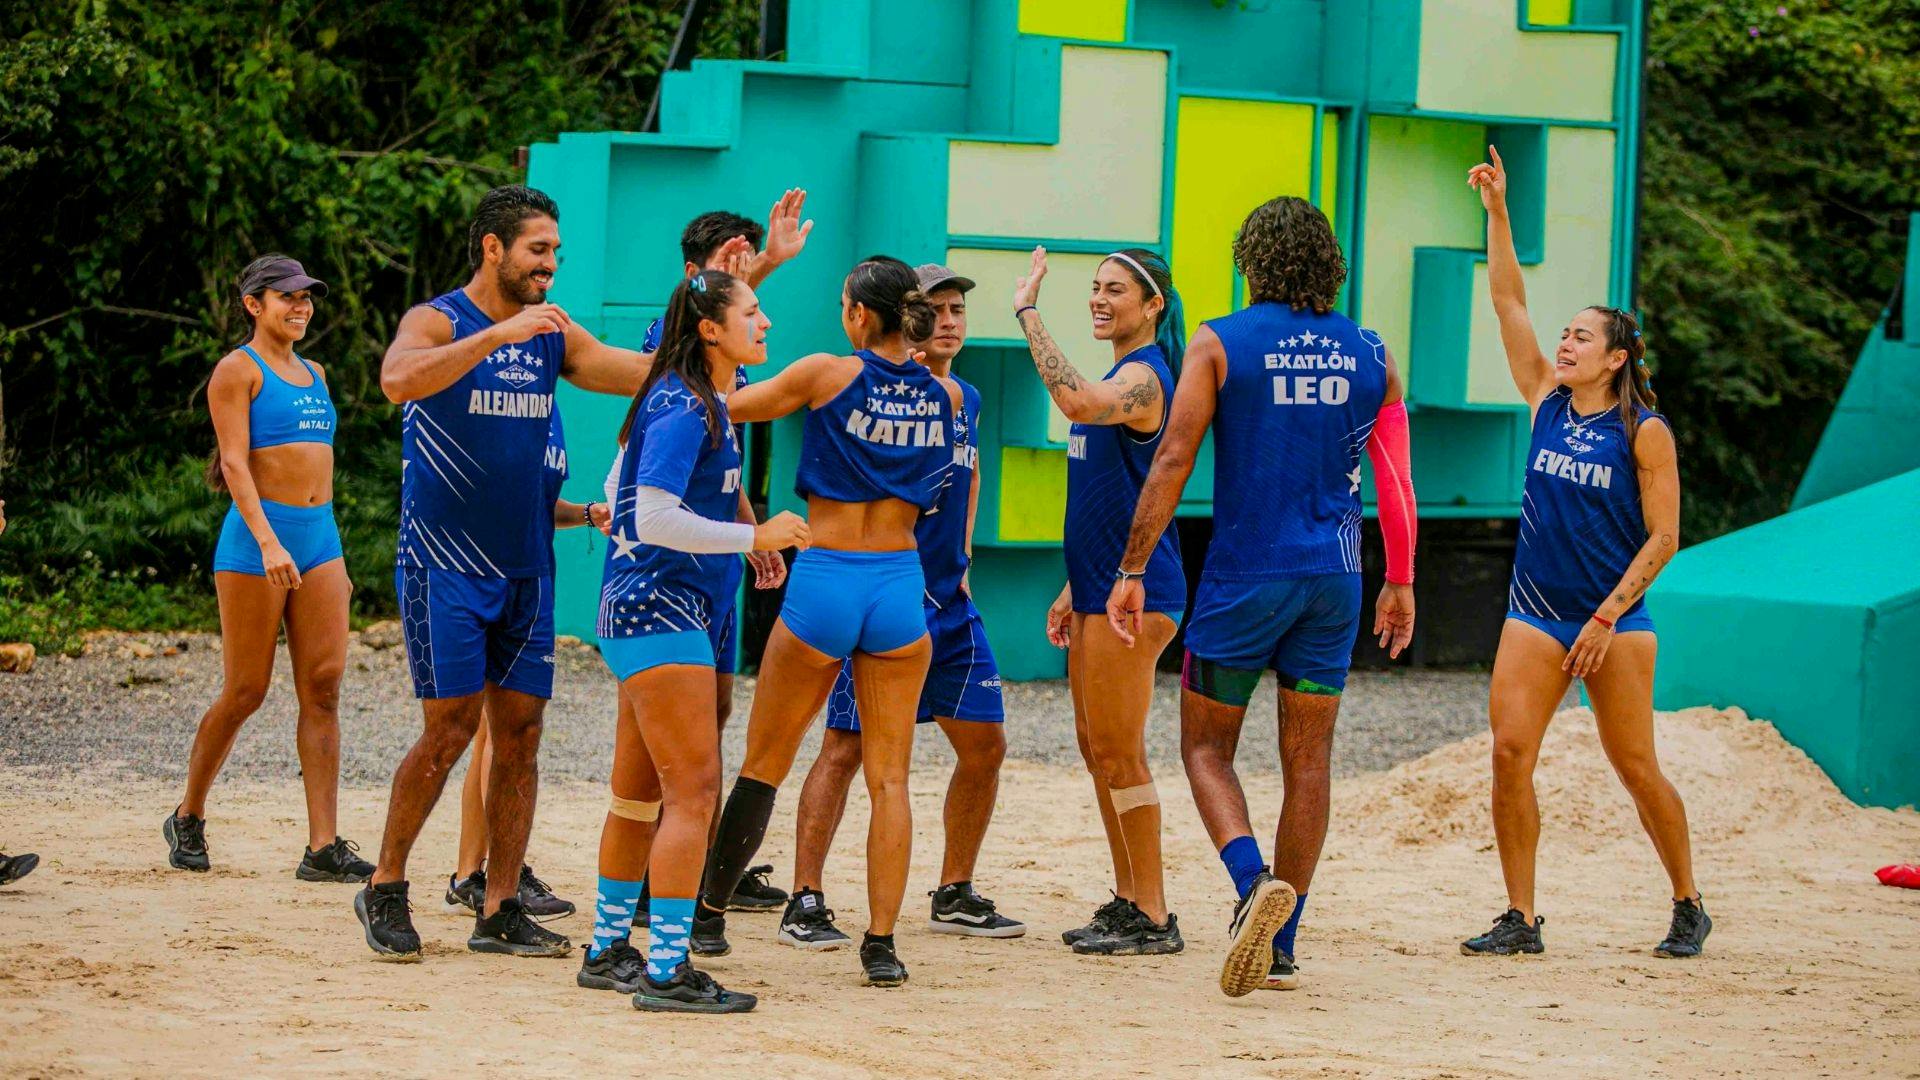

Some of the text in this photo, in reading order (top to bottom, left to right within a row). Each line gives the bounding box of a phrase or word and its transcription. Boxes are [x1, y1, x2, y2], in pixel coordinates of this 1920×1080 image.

[1273, 375, 1350, 406] LEO
[846, 409, 946, 447] KATIA
[1534, 448, 1613, 490] EVELYN
